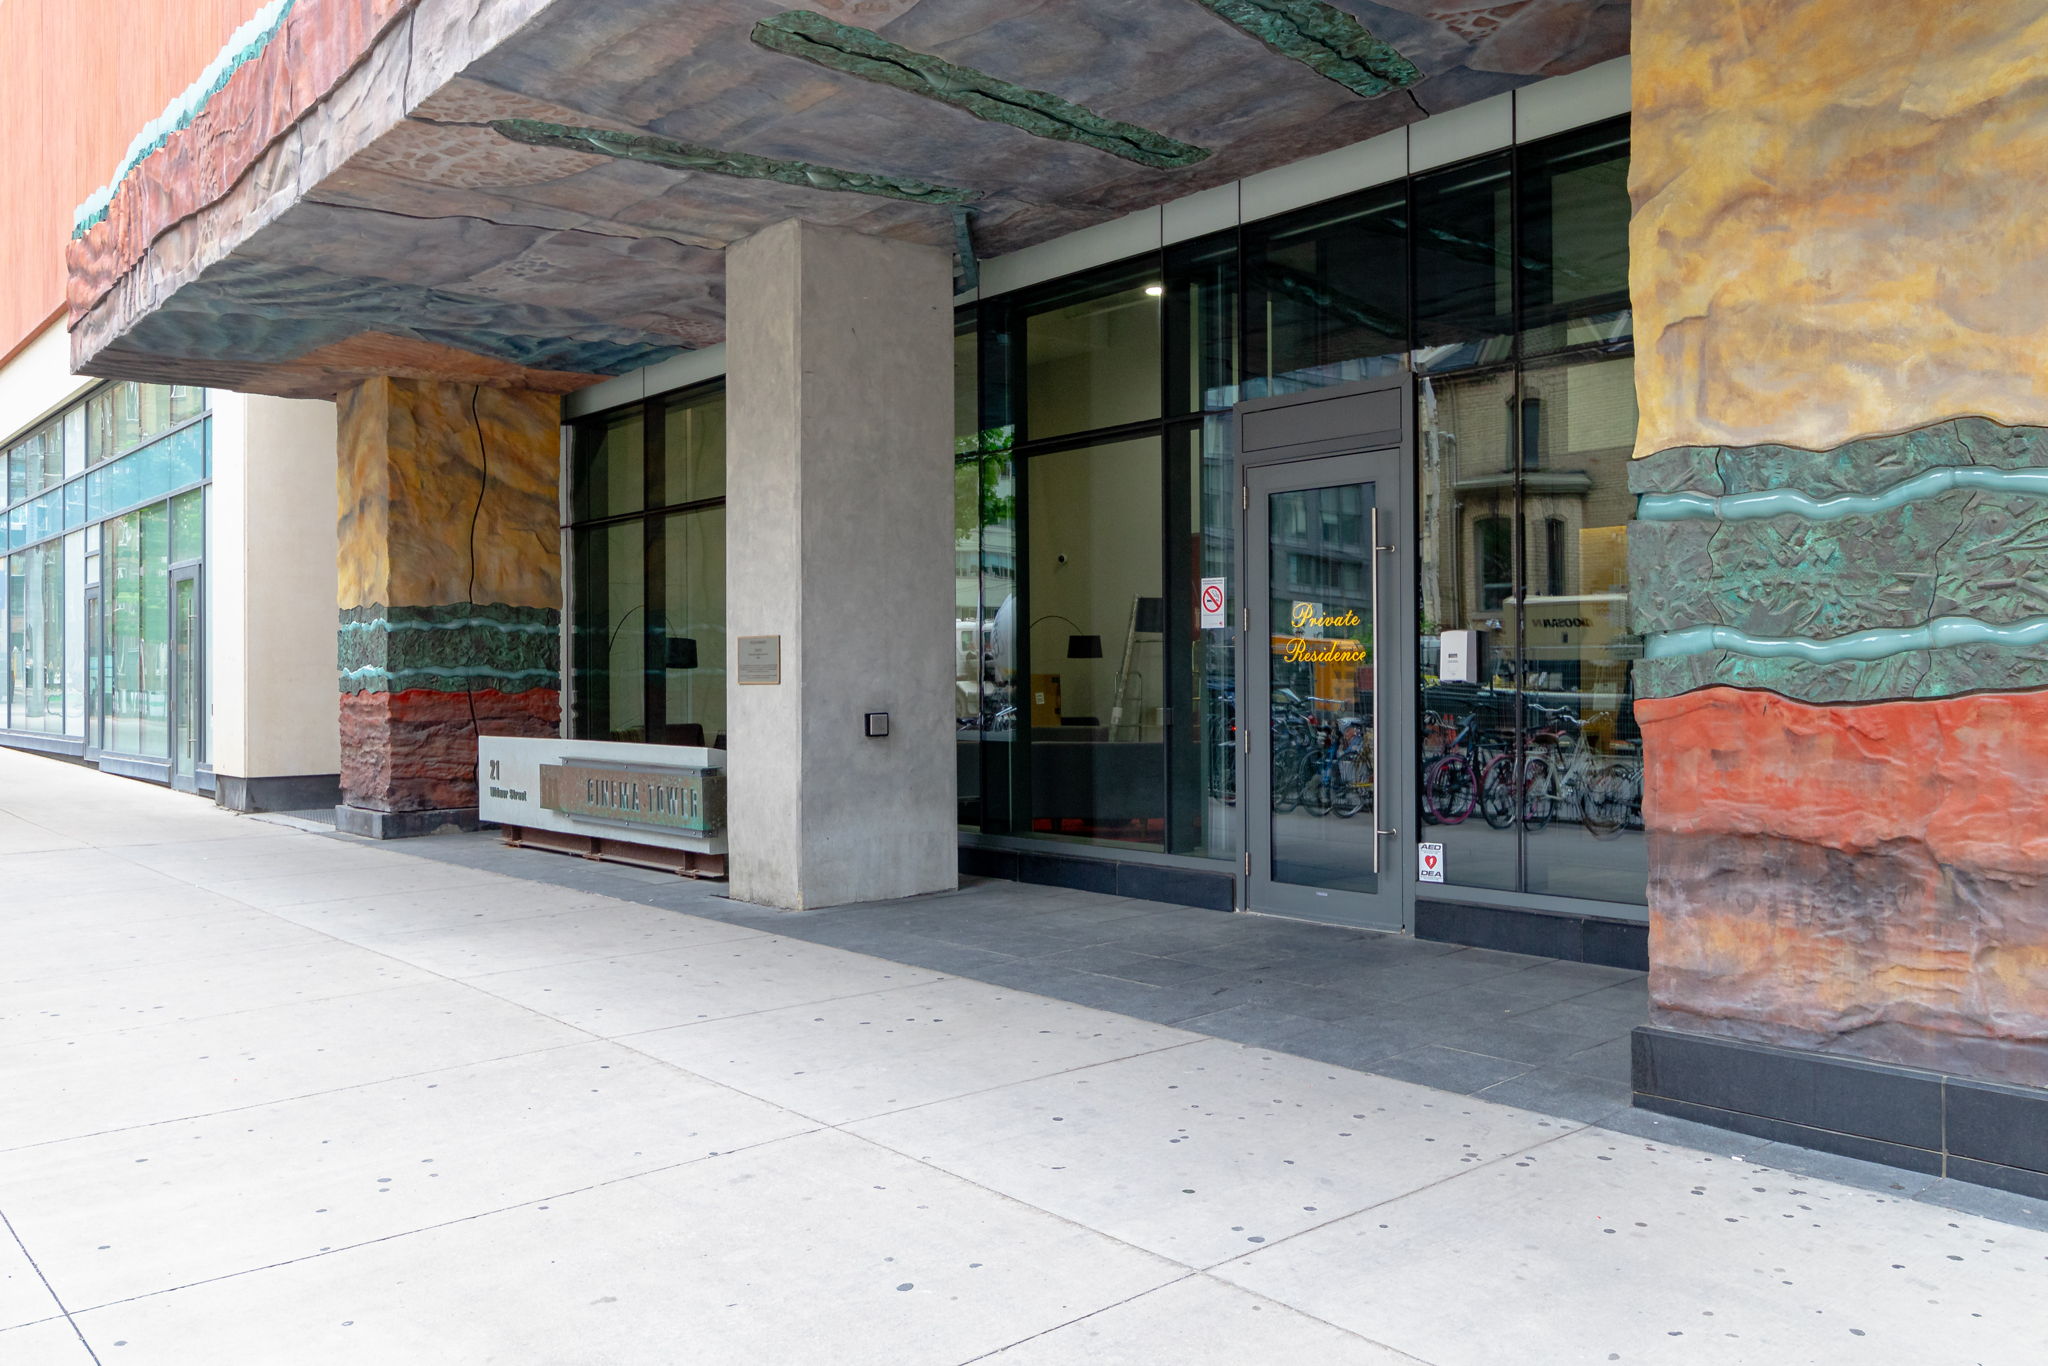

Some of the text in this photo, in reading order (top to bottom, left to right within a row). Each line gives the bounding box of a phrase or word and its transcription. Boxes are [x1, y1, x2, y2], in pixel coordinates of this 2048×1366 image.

[1291, 602, 1360, 628] Private
[1284, 638, 1366, 662] Residence
[489, 759, 500, 780] 21
[509, 788, 527, 802] Street
[587, 778, 698, 818] CINEMA TOWER
